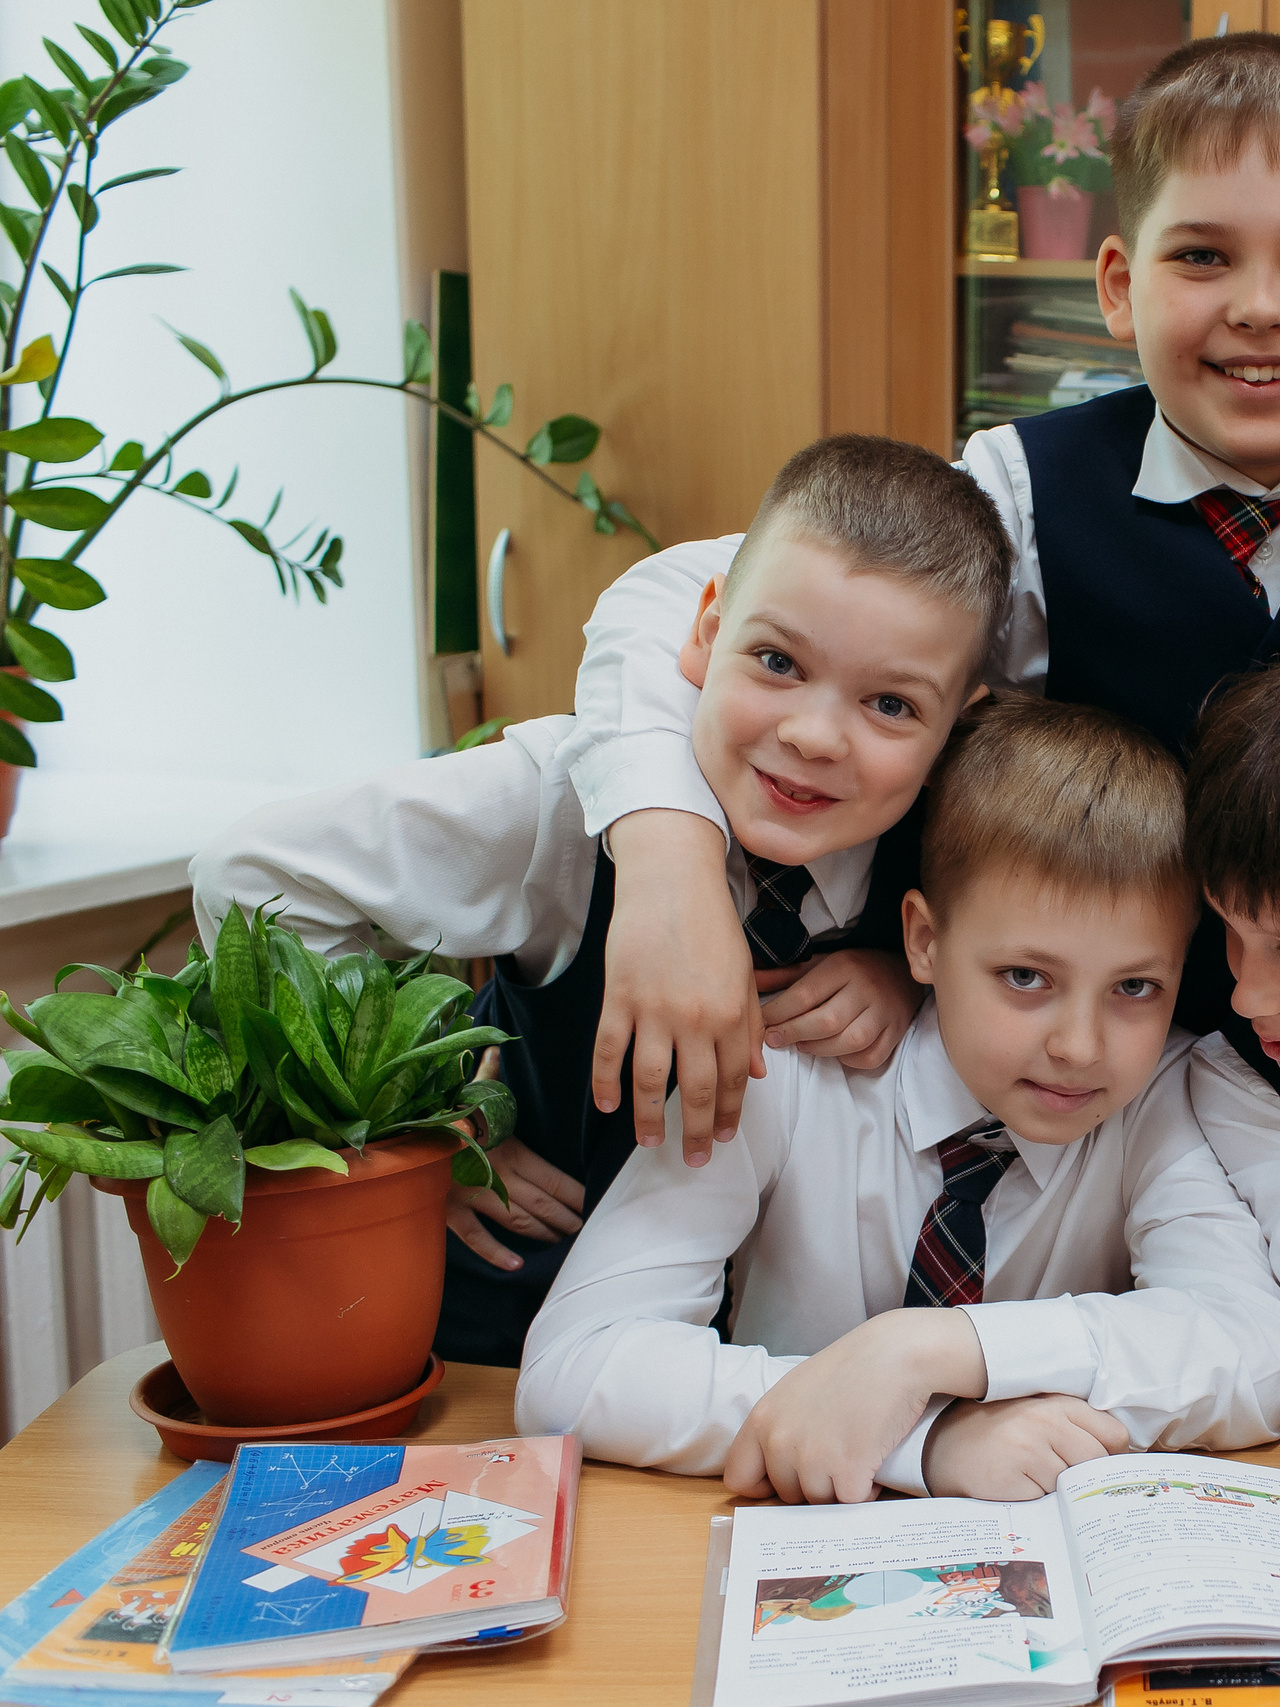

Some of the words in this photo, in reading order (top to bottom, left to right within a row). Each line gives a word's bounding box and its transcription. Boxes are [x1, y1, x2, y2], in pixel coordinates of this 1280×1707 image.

[269, 1479, 449, 1556] Математика
[298, 1519, 332, 1535] Часть
[260, 1533, 299, 1551] вторая
[468, 1579, 496, 1599] 3
